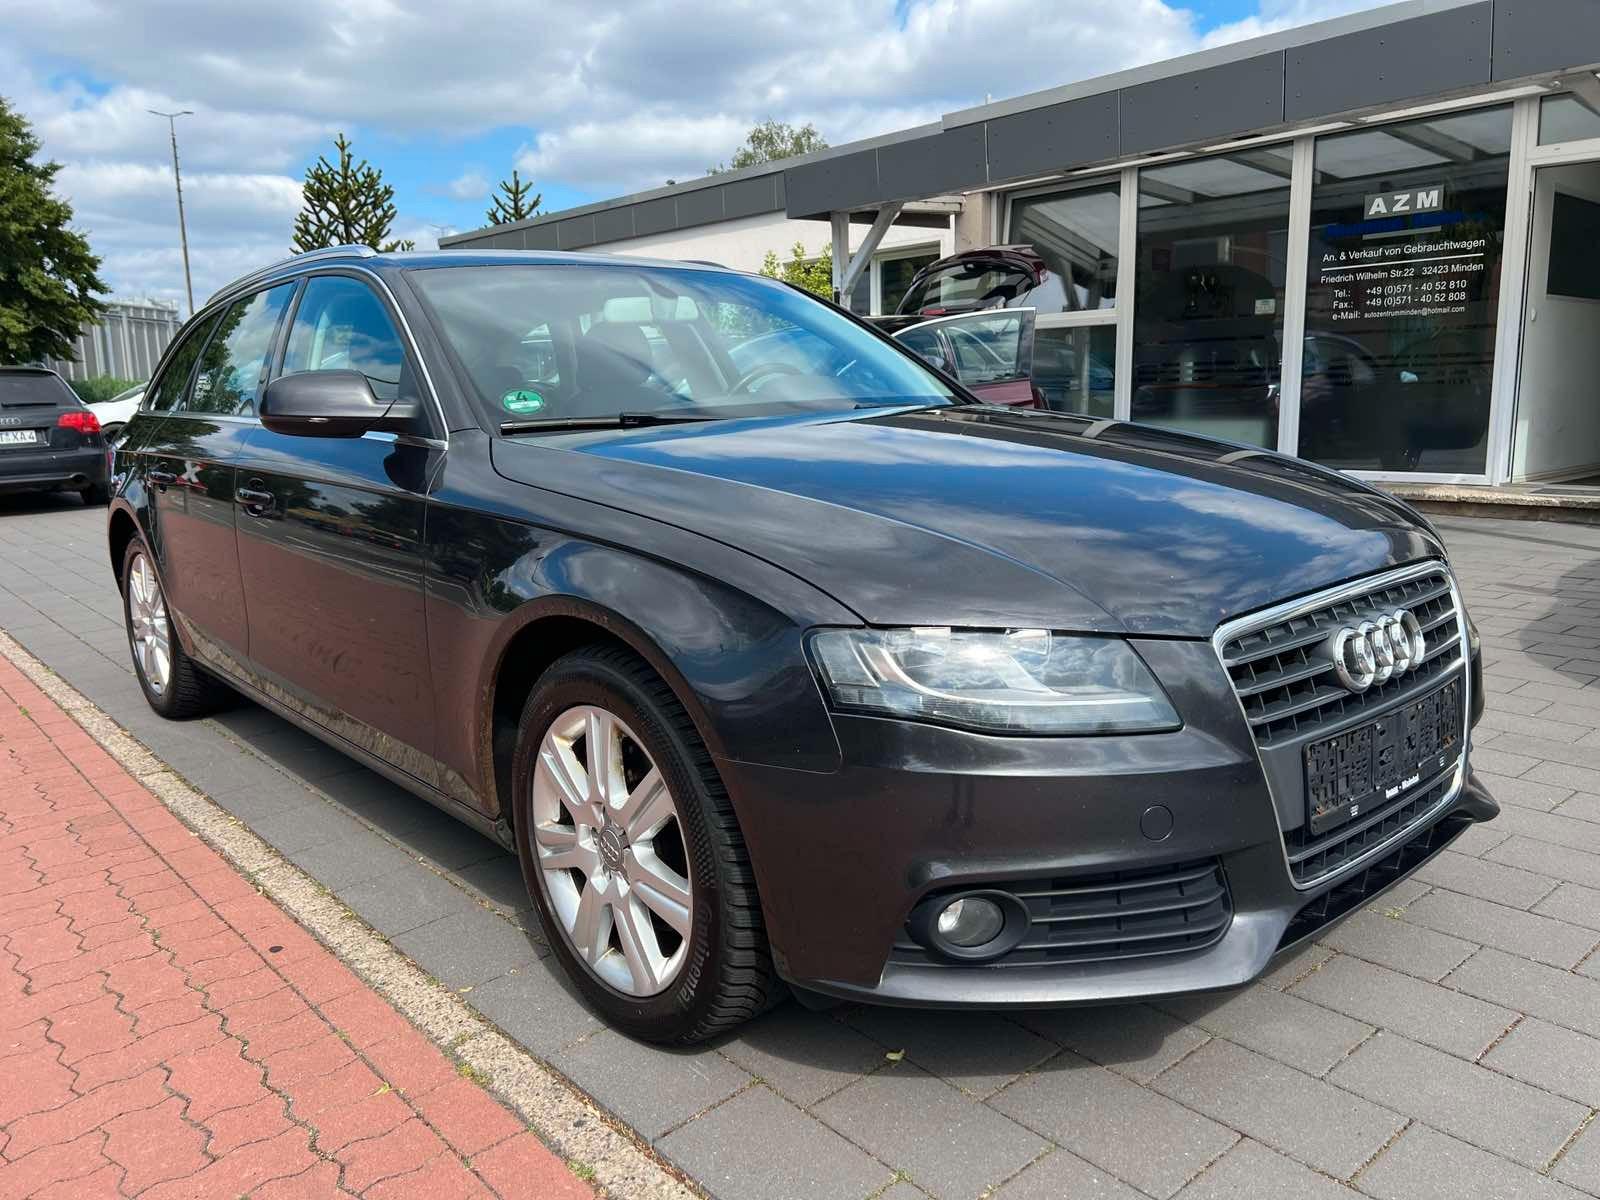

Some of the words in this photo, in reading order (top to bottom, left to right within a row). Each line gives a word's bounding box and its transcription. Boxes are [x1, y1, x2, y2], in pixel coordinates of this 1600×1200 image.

[1340, 251, 1346, 260] &
[1348, 248, 1383, 259] Verkauf
[1384, 247, 1401, 256] von
[1403, 239, 1485, 254] Gebrauchtwagen
[1320, 273, 1354, 284] Friedrich
[1356, 271, 1388, 281] Wilhelm
[1421, 264, 1449, 275] 32423
[1451, 263, 1484, 272] Minden
[1366, 286, 1382, 295] +49
[1384, 284, 1412, 296] (0)571
[1421, 282, 1433, 291] 40
[1435, 281, 1447, 290] 52
[1449, 279, 1467, 289] 810
[1366, 298, 1382, 306] +49
[1384, 295, 1412, 307] (0)571
[1420, 294, 1432, 302] 40
[1434, 293, 1446, 302] 52
[1448, 291, 1466, 301] 808
[1332, 310, 1361, 320] e-Mail:
